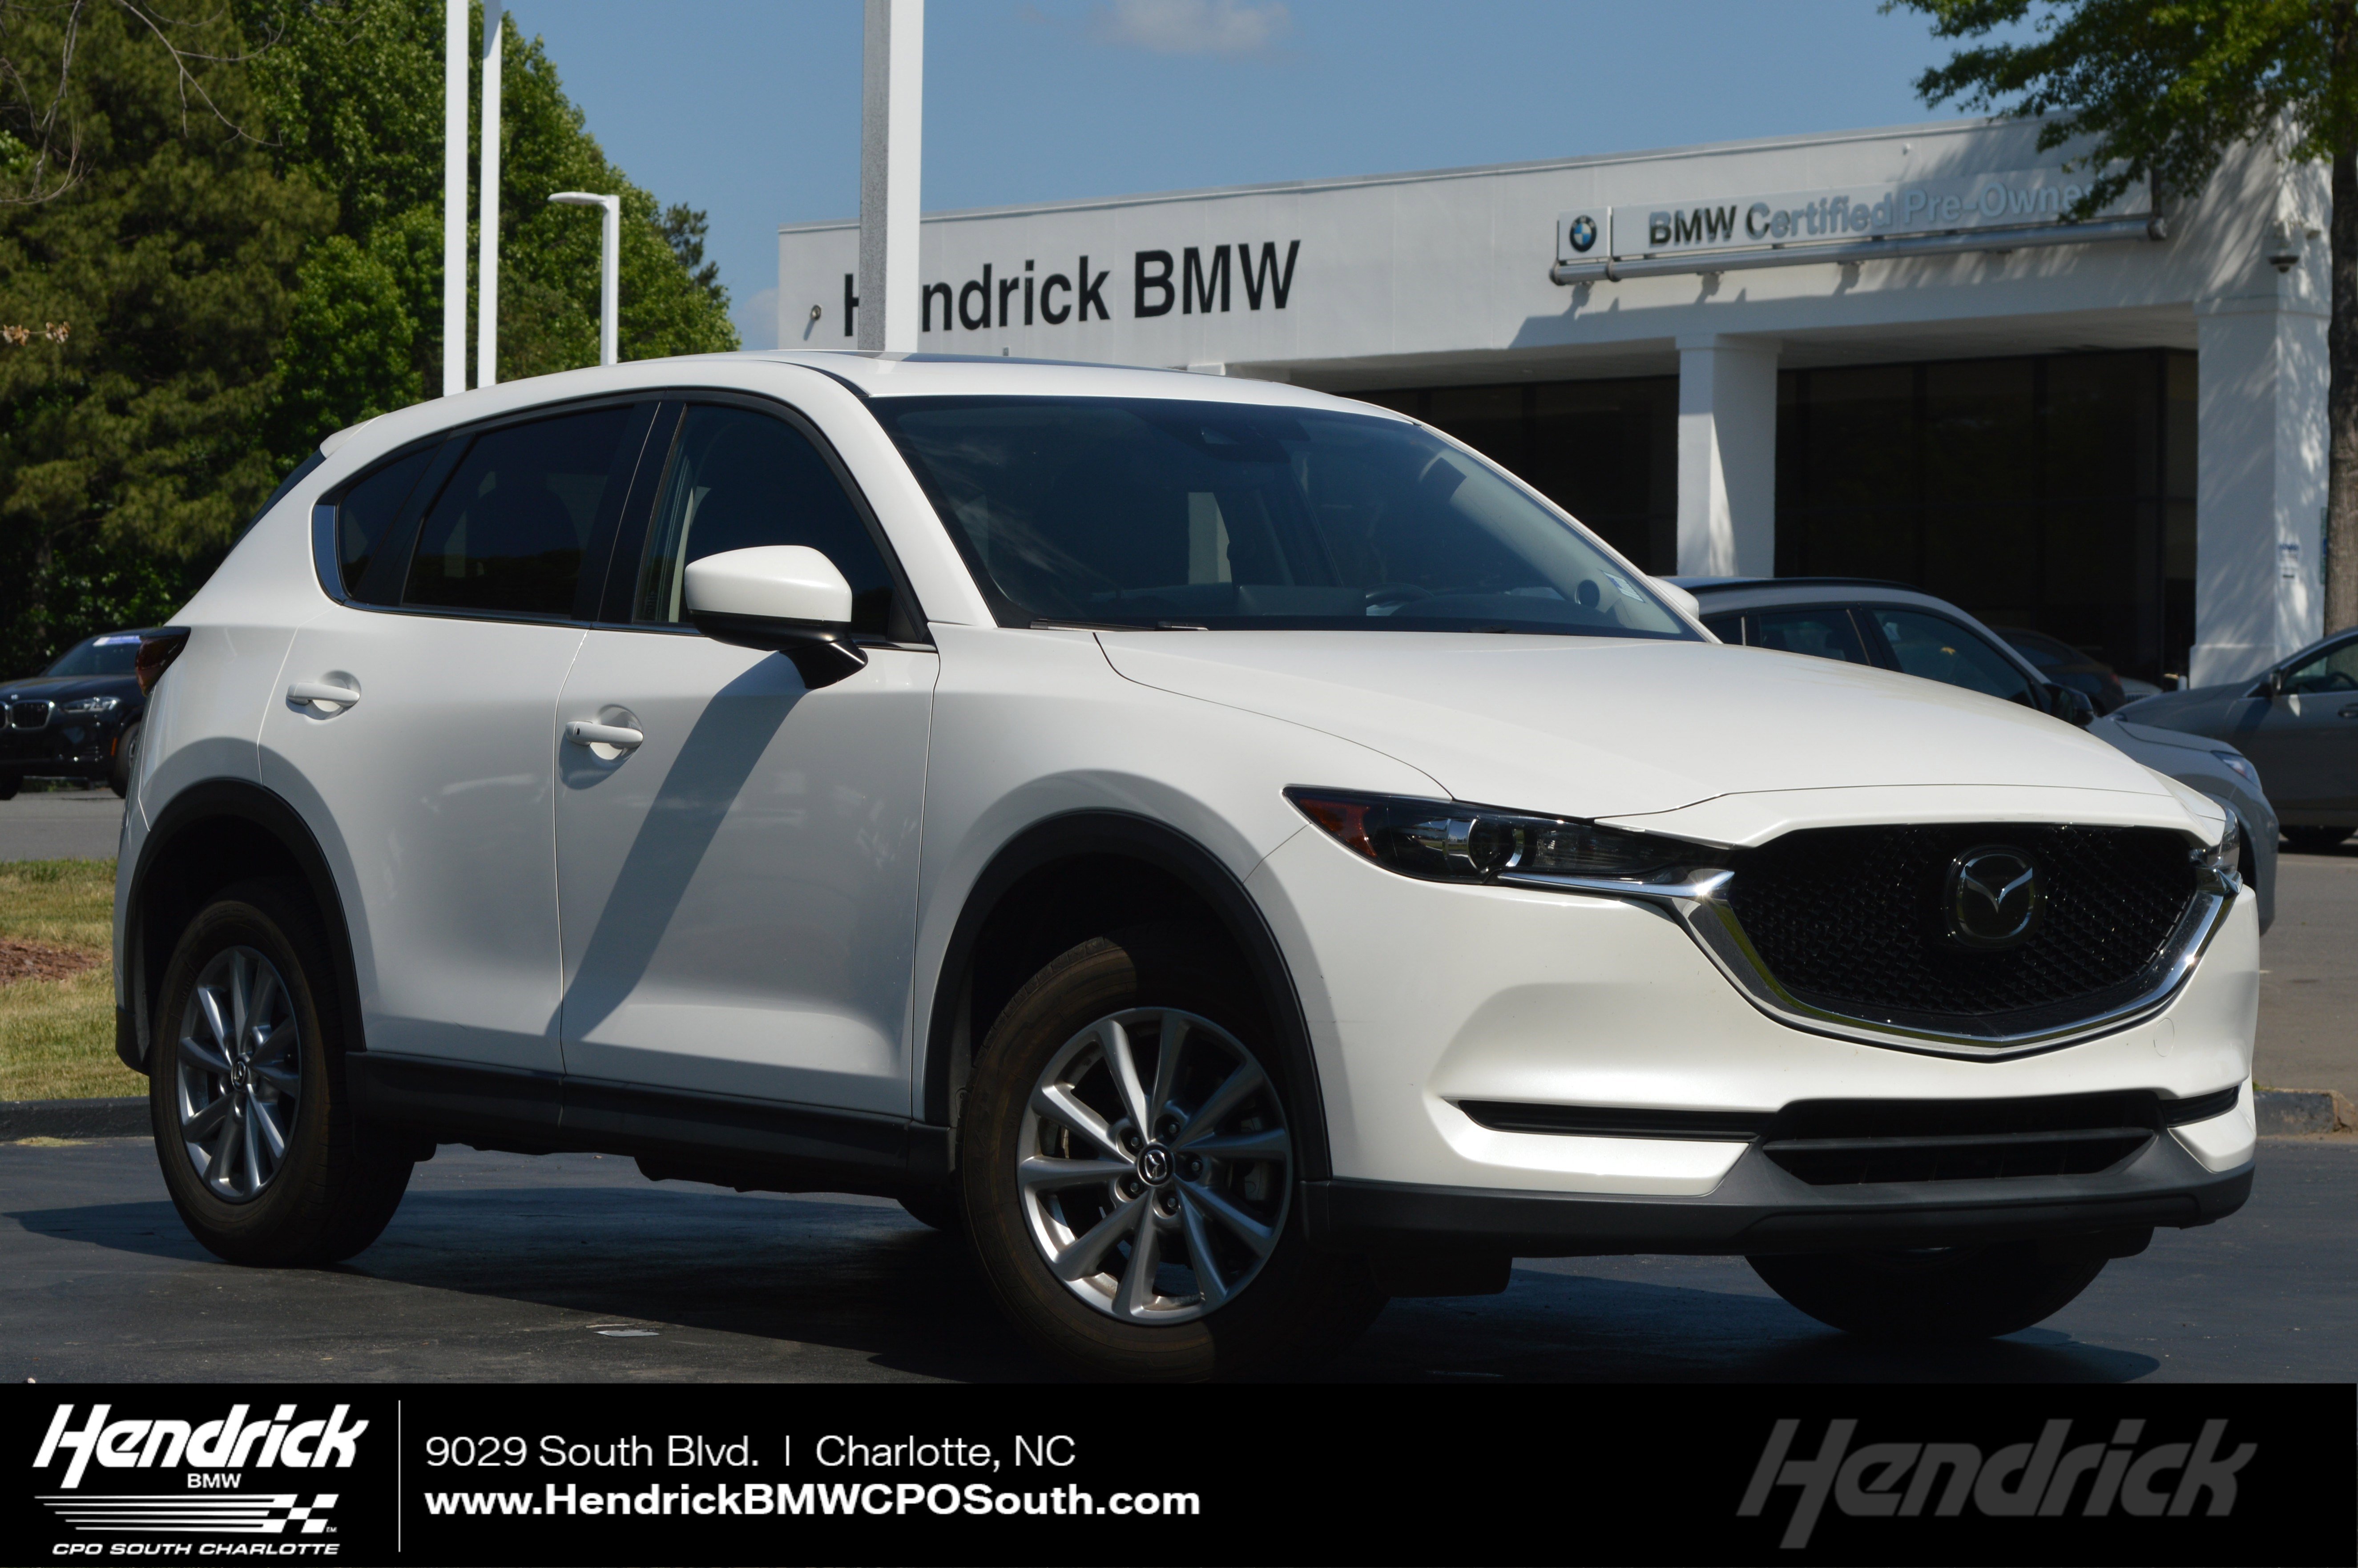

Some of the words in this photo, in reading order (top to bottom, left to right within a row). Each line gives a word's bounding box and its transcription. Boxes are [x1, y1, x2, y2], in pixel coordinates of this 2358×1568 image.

[1649, 205, 1737, 247] BMW
[1745, 192, 1893, 241] Certified
[1904, 172, 2104, 223] Pre-Owne
[844, 256, 1110, 337] ndrick
[1135, 240, 1300, 318] BMW
